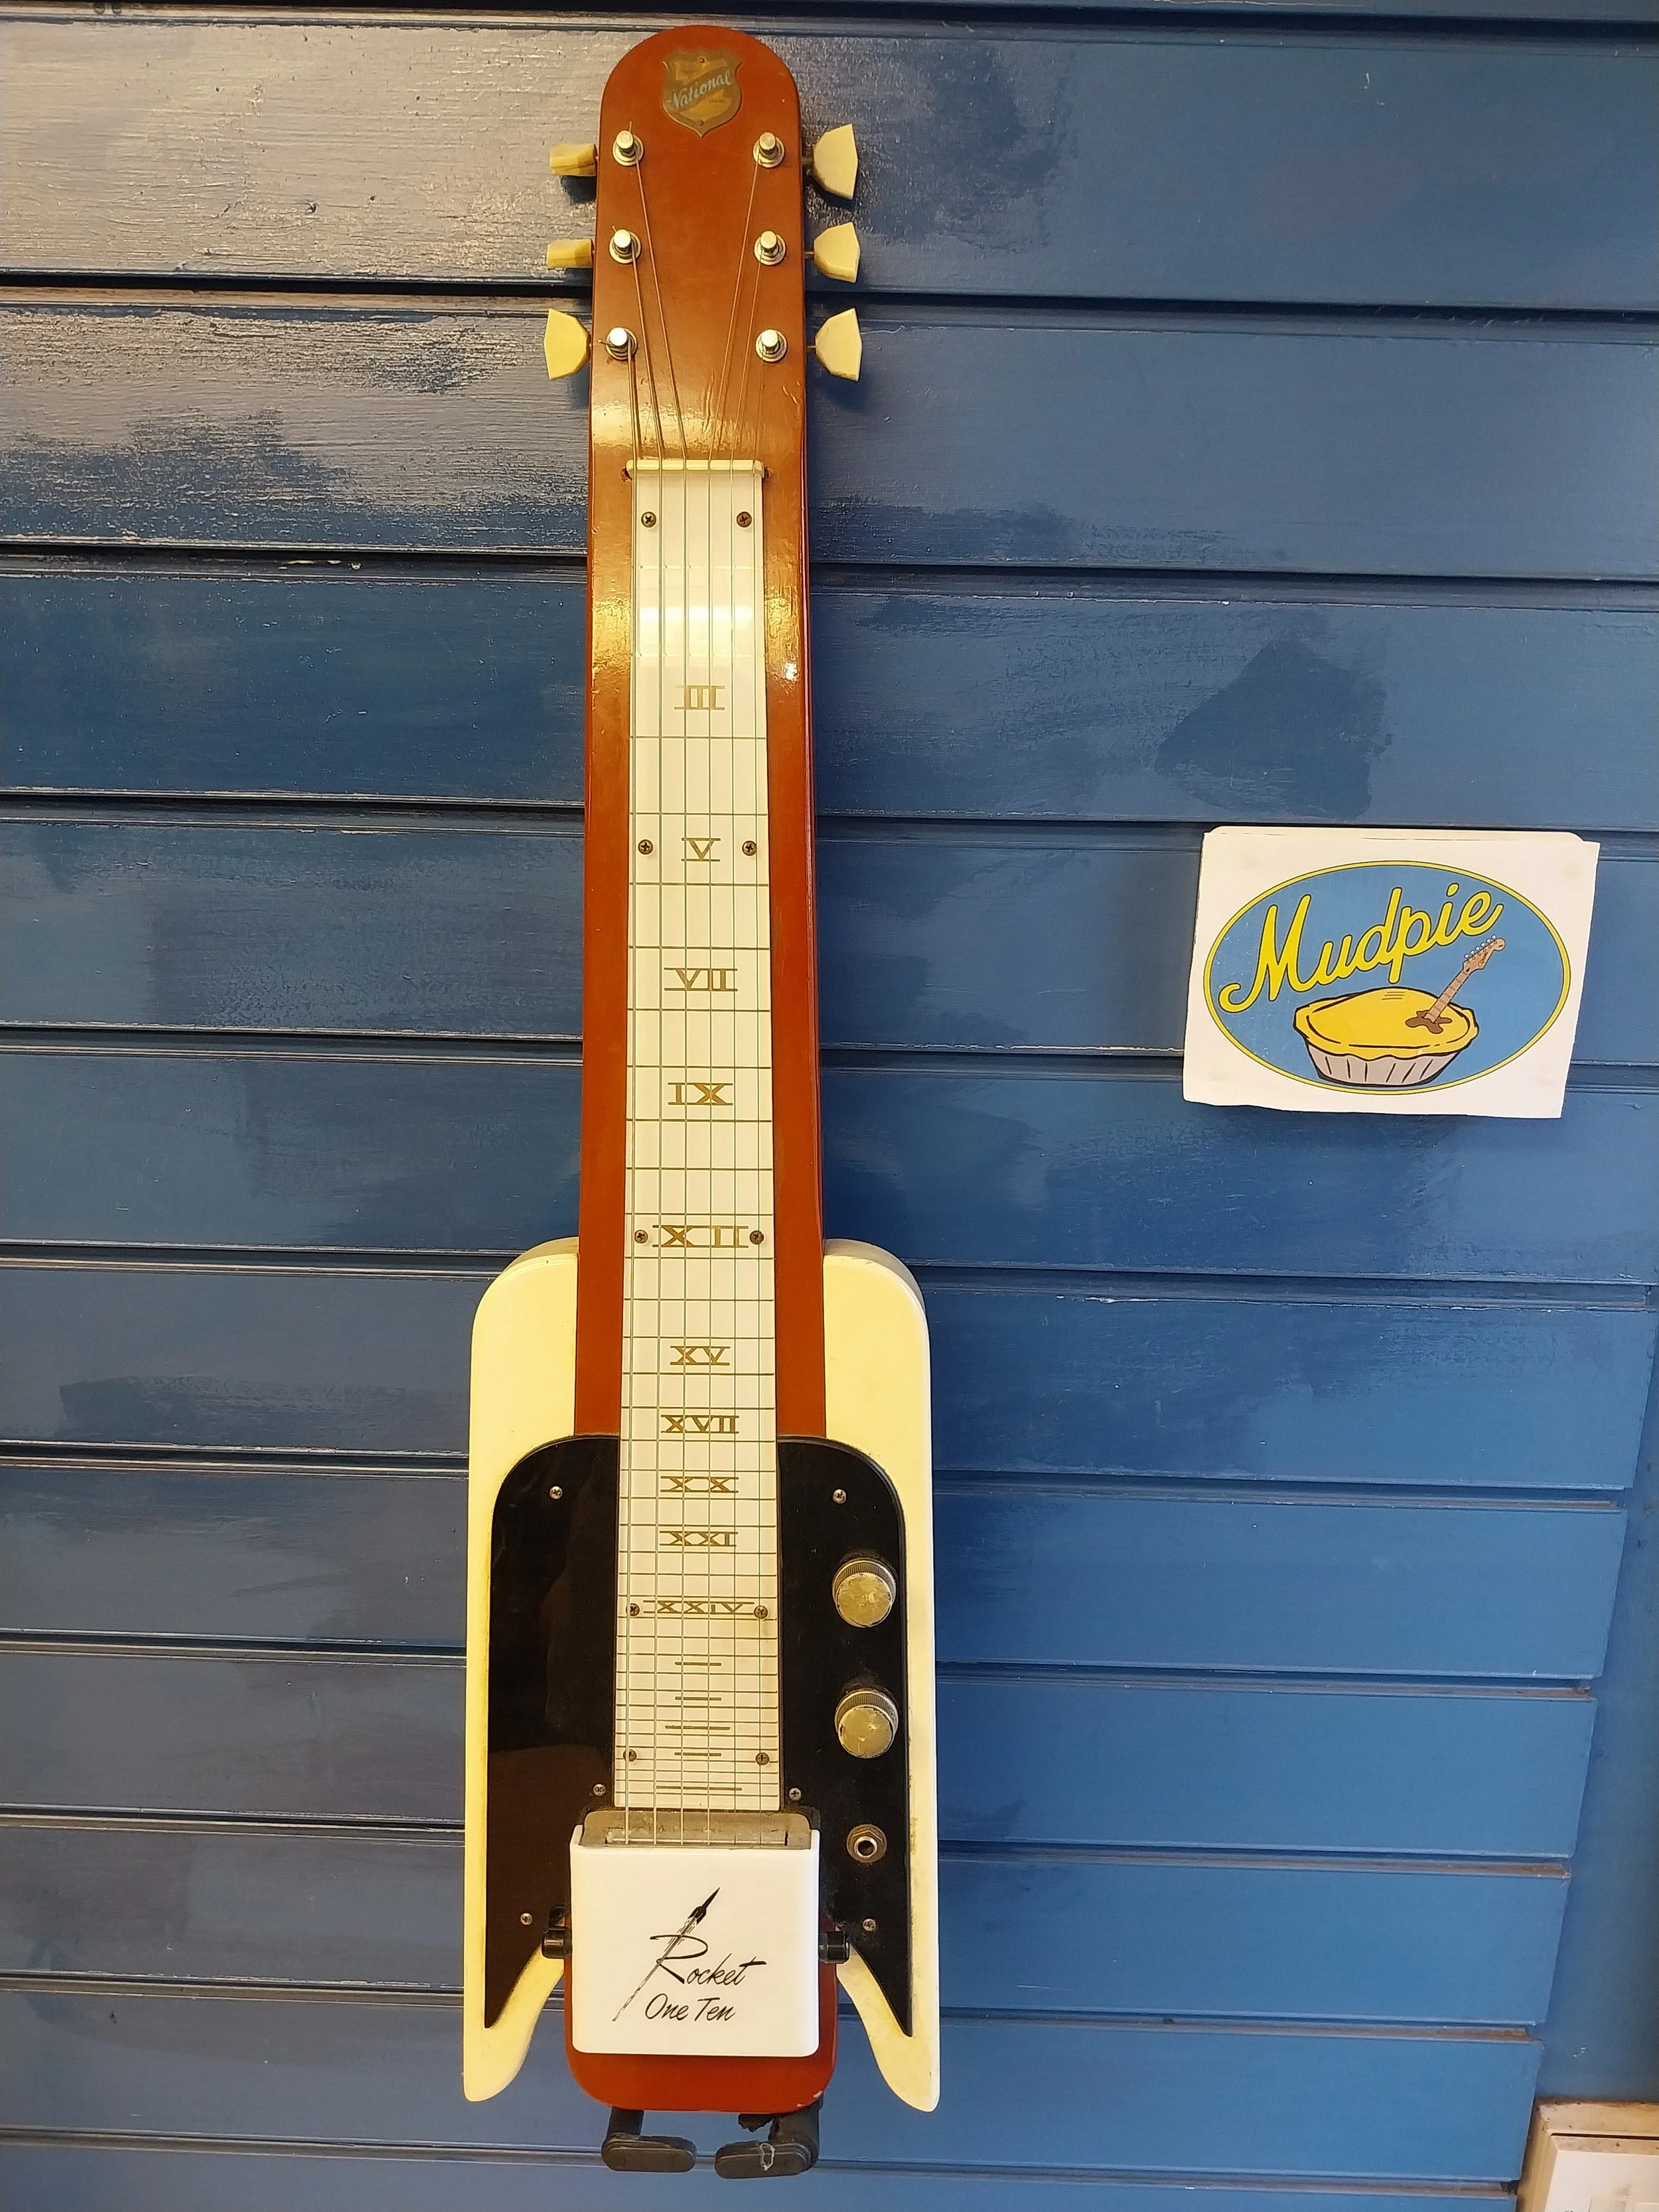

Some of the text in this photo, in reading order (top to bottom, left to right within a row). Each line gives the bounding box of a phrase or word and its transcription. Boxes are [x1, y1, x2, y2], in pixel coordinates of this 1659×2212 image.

[666, 68, 733, 111] National
[681, 837, 721, 862] V
[1218, 882, 1504, 1013] Mudpie
[664, 967, 739, 992] VII
[668, 1082, 733, 1106] IX
[652, 1224, 749, 1248] XII
[670, 1345, 731, 1366] XV
[660, 1414, 740, 1434] XVII
[660, 1475, 739, 1493] XX
[659, 1530, 739, 1547] XXI
[644, 1993, 737, 2022] One Ten
